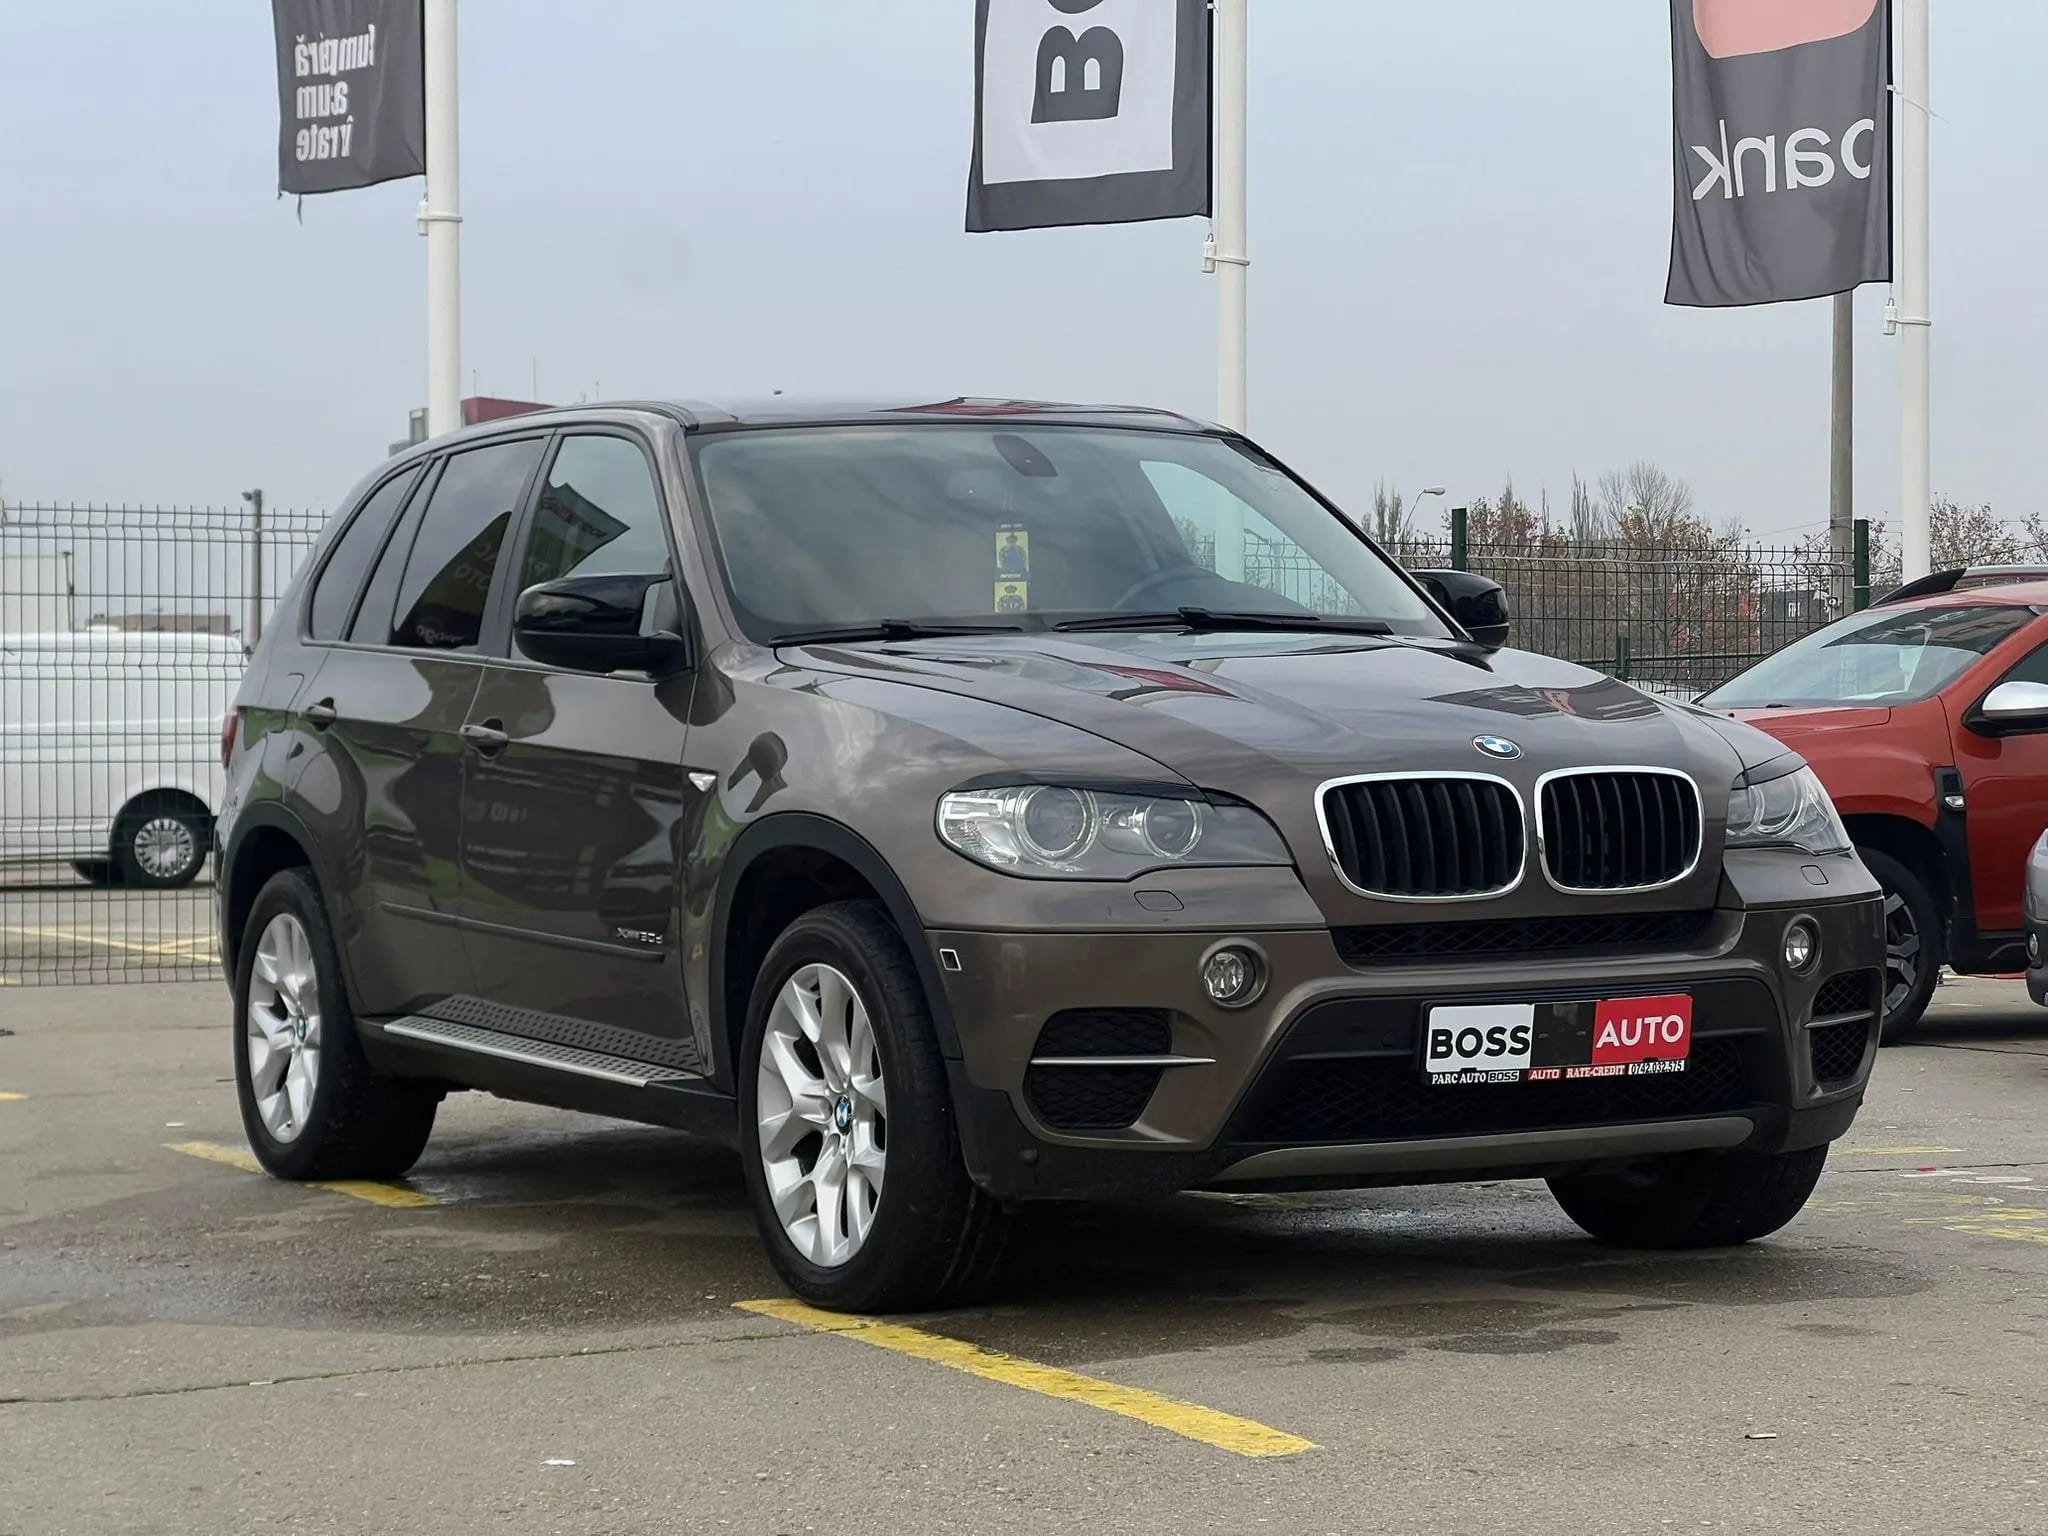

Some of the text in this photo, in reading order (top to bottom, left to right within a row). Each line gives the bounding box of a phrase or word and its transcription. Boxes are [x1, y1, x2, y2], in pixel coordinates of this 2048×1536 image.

[1030, 0, 1125, 124] B
[1430, 1025, 1531, 1060] BOSS
[1595, 1014, 1685, 1049] AUTO
[1431, 1071, 1519, 1085] PARC AUTO BOSS
[1530, 1069, 1560, 1080] AUTO
[1566, 1065, 1625, 1078] RATE-CREDIT
